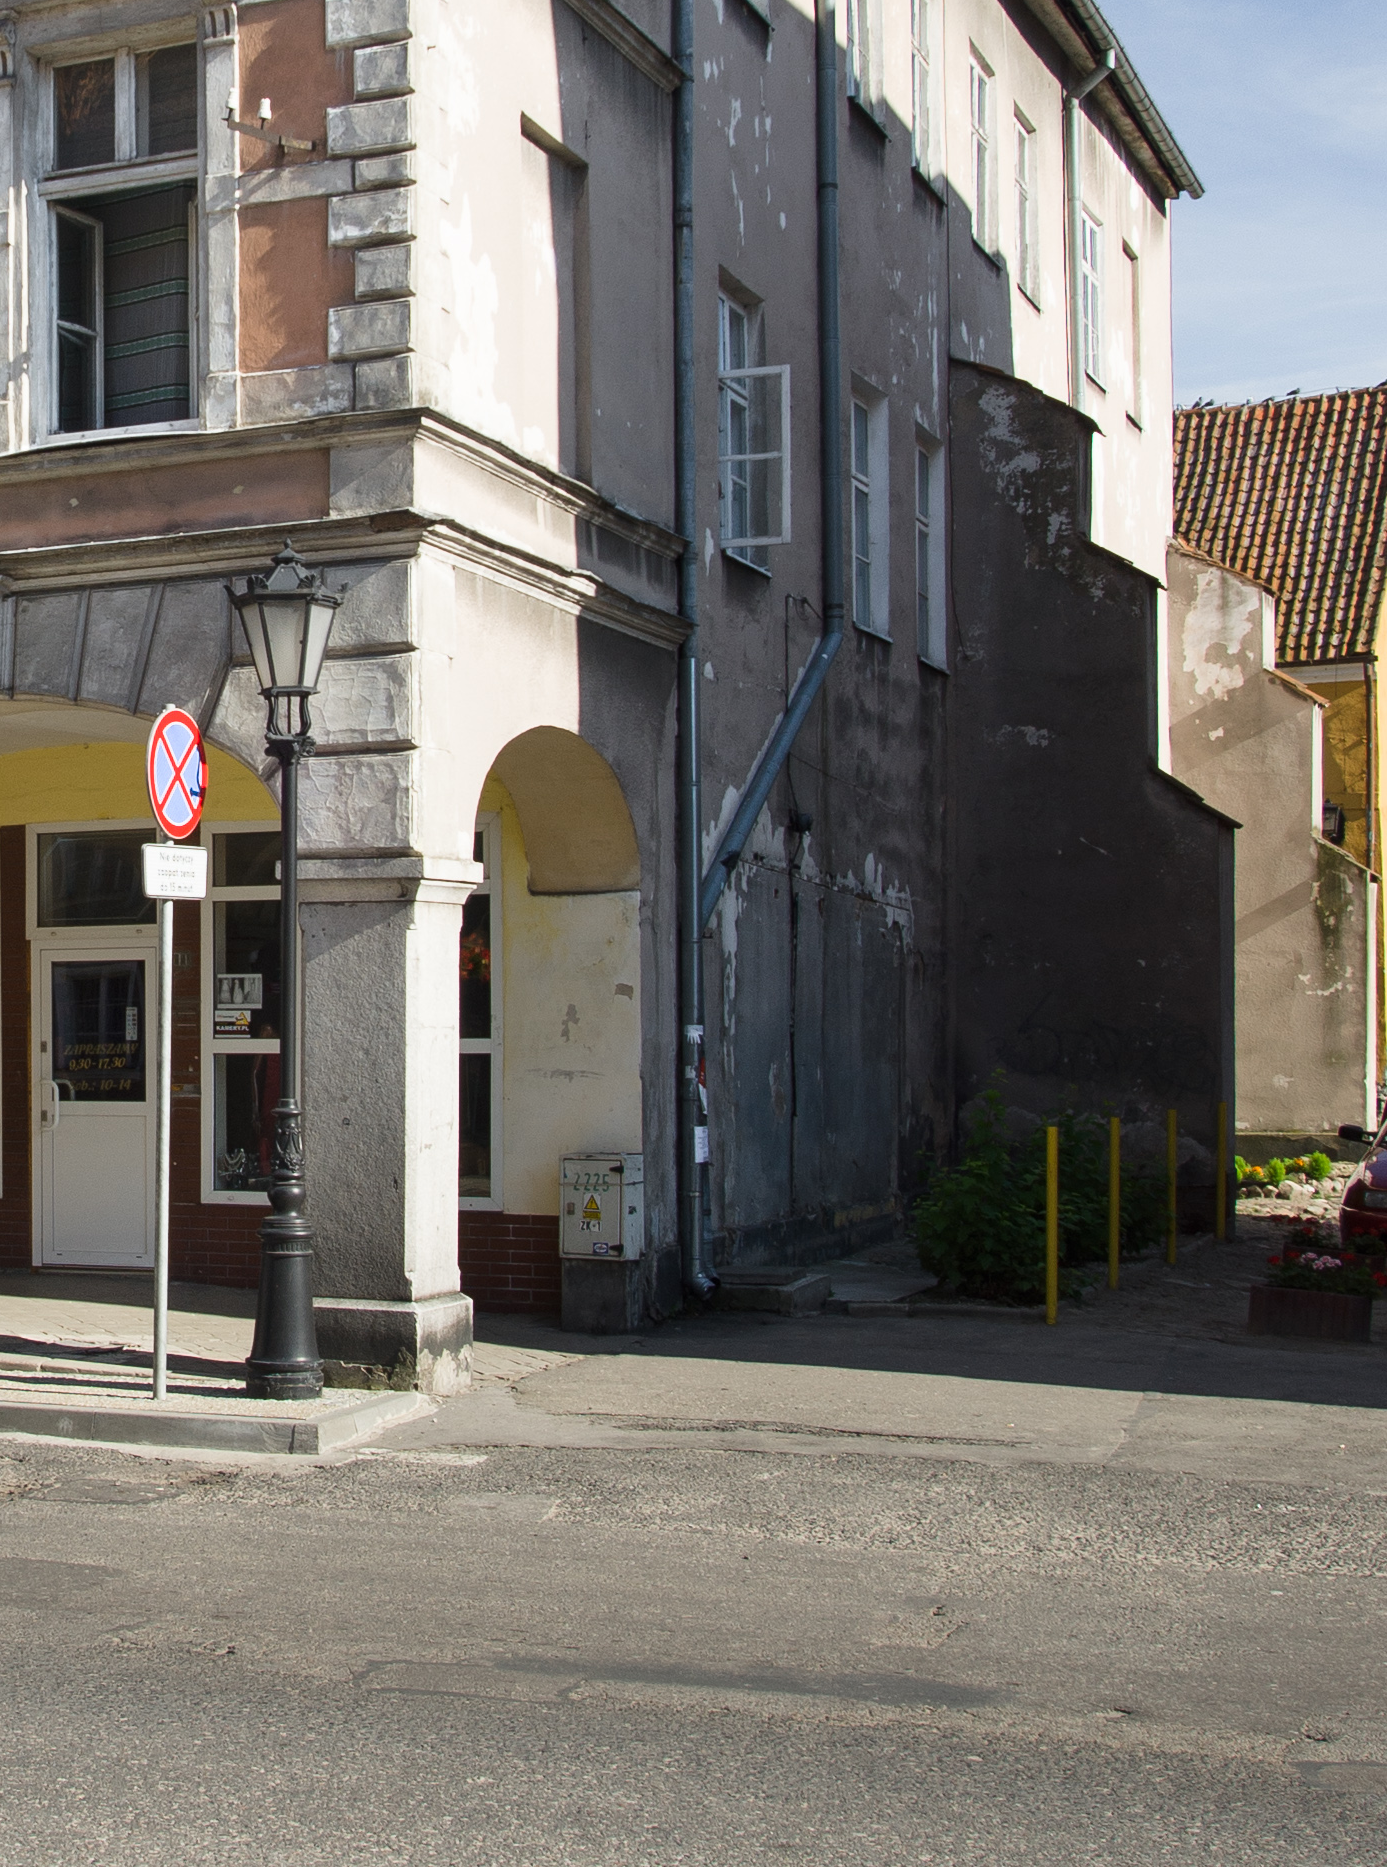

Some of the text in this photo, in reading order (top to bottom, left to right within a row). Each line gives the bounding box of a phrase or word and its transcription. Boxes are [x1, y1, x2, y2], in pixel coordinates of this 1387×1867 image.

[159, 851, 194, 866] Nie dotyczy
[64, 1043, 139, 1055] ZAPRASZAMY
[573, 1173, 610, 1192] 2225
